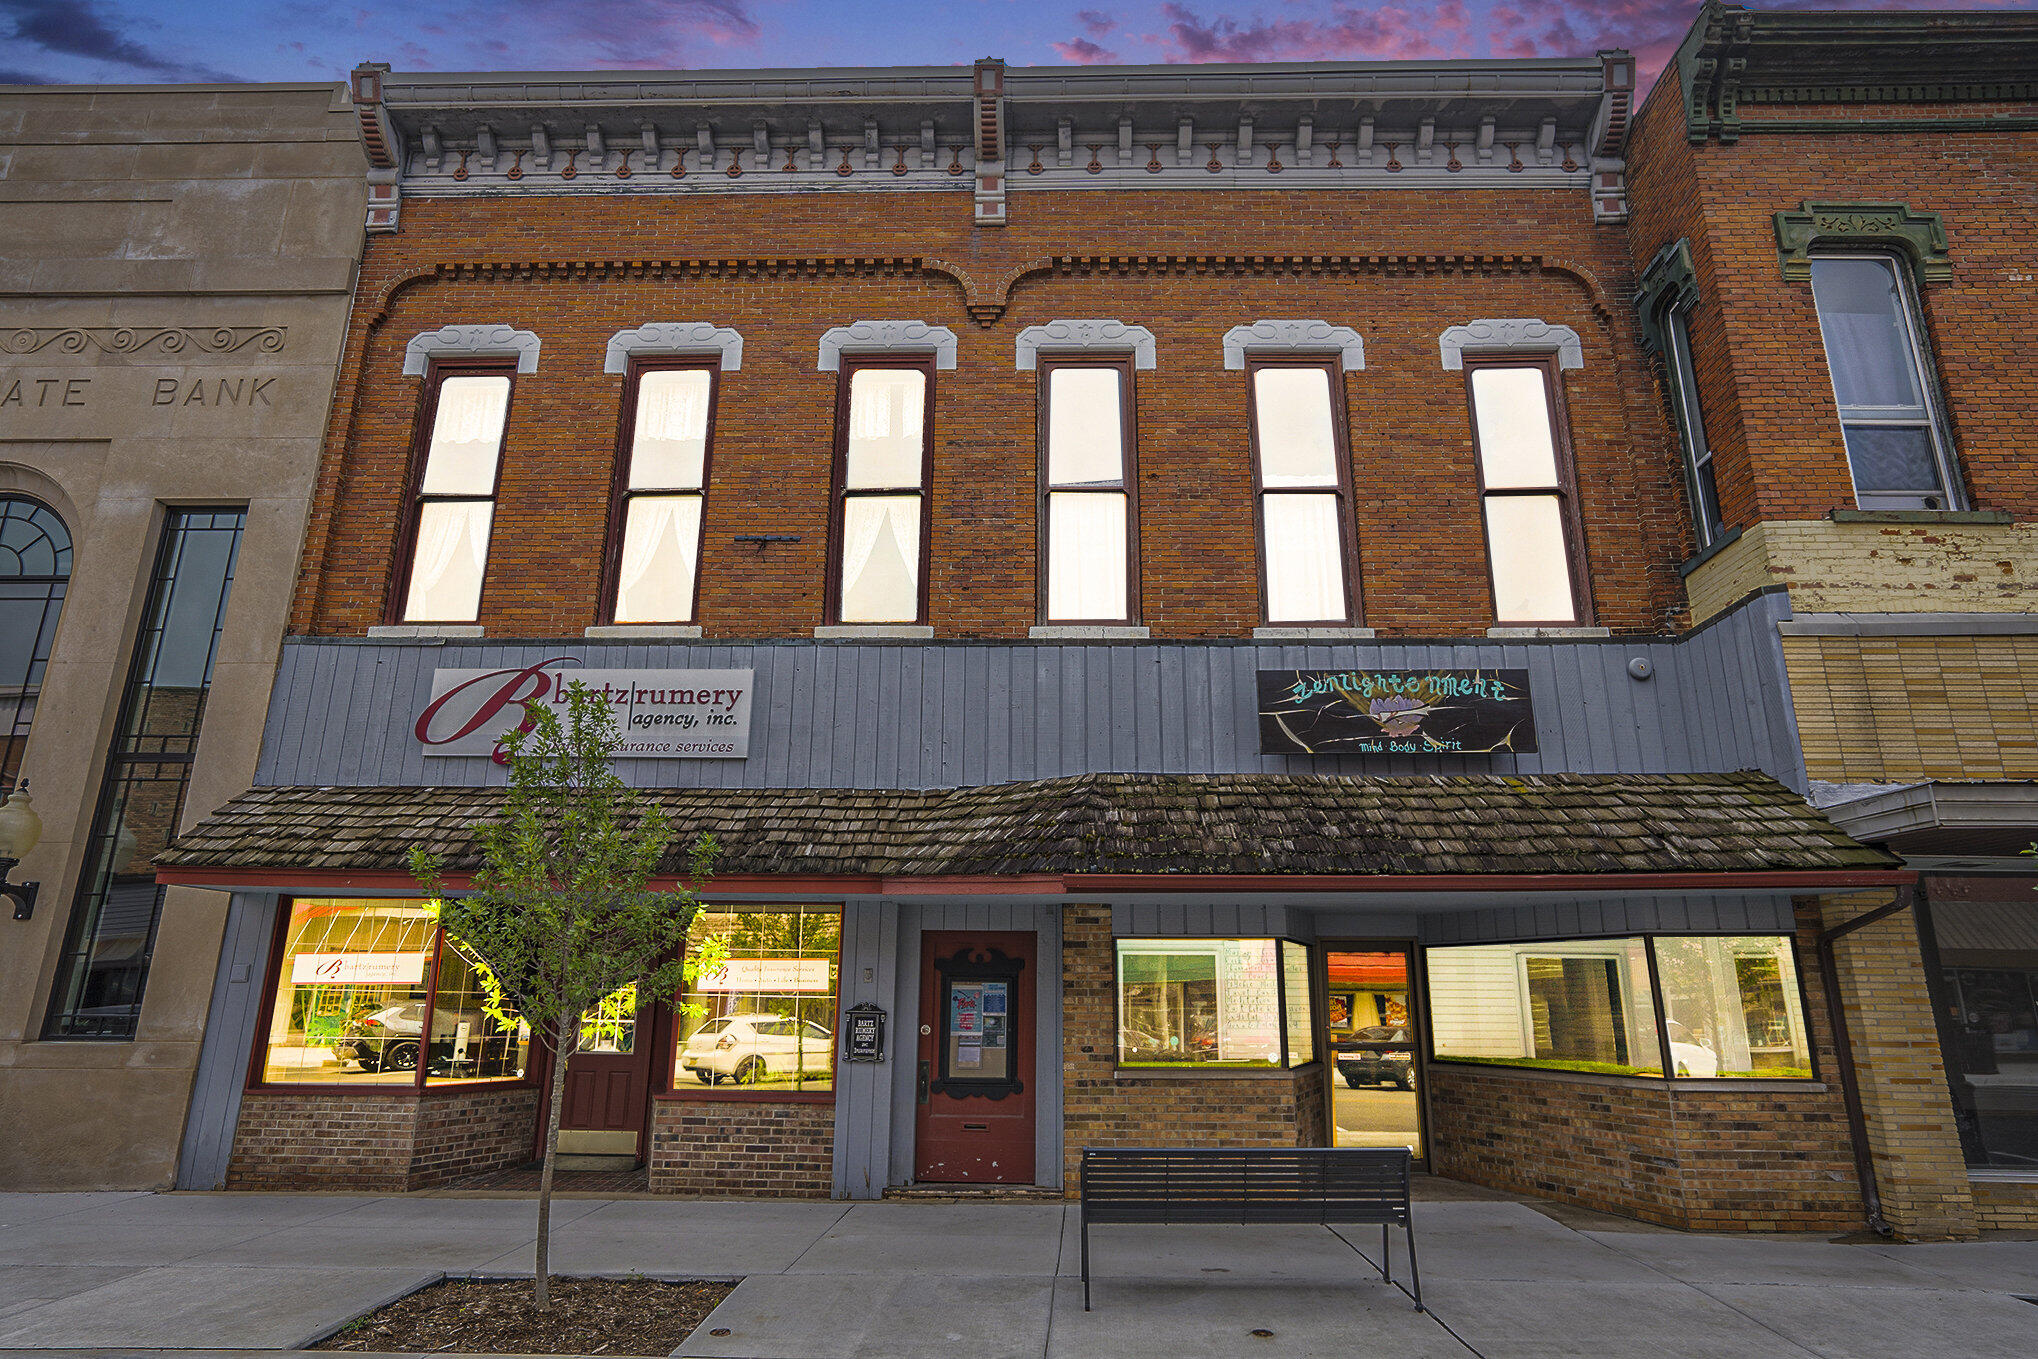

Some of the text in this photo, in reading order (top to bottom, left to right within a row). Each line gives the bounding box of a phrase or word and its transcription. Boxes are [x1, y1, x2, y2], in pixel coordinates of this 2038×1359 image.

[1, 378, 278, 407] ATE BANK
[633, 709, 738, 727] agency, inc.
[675, 739, 734, 752] services
[1389, 740, 1416, 753] Body
